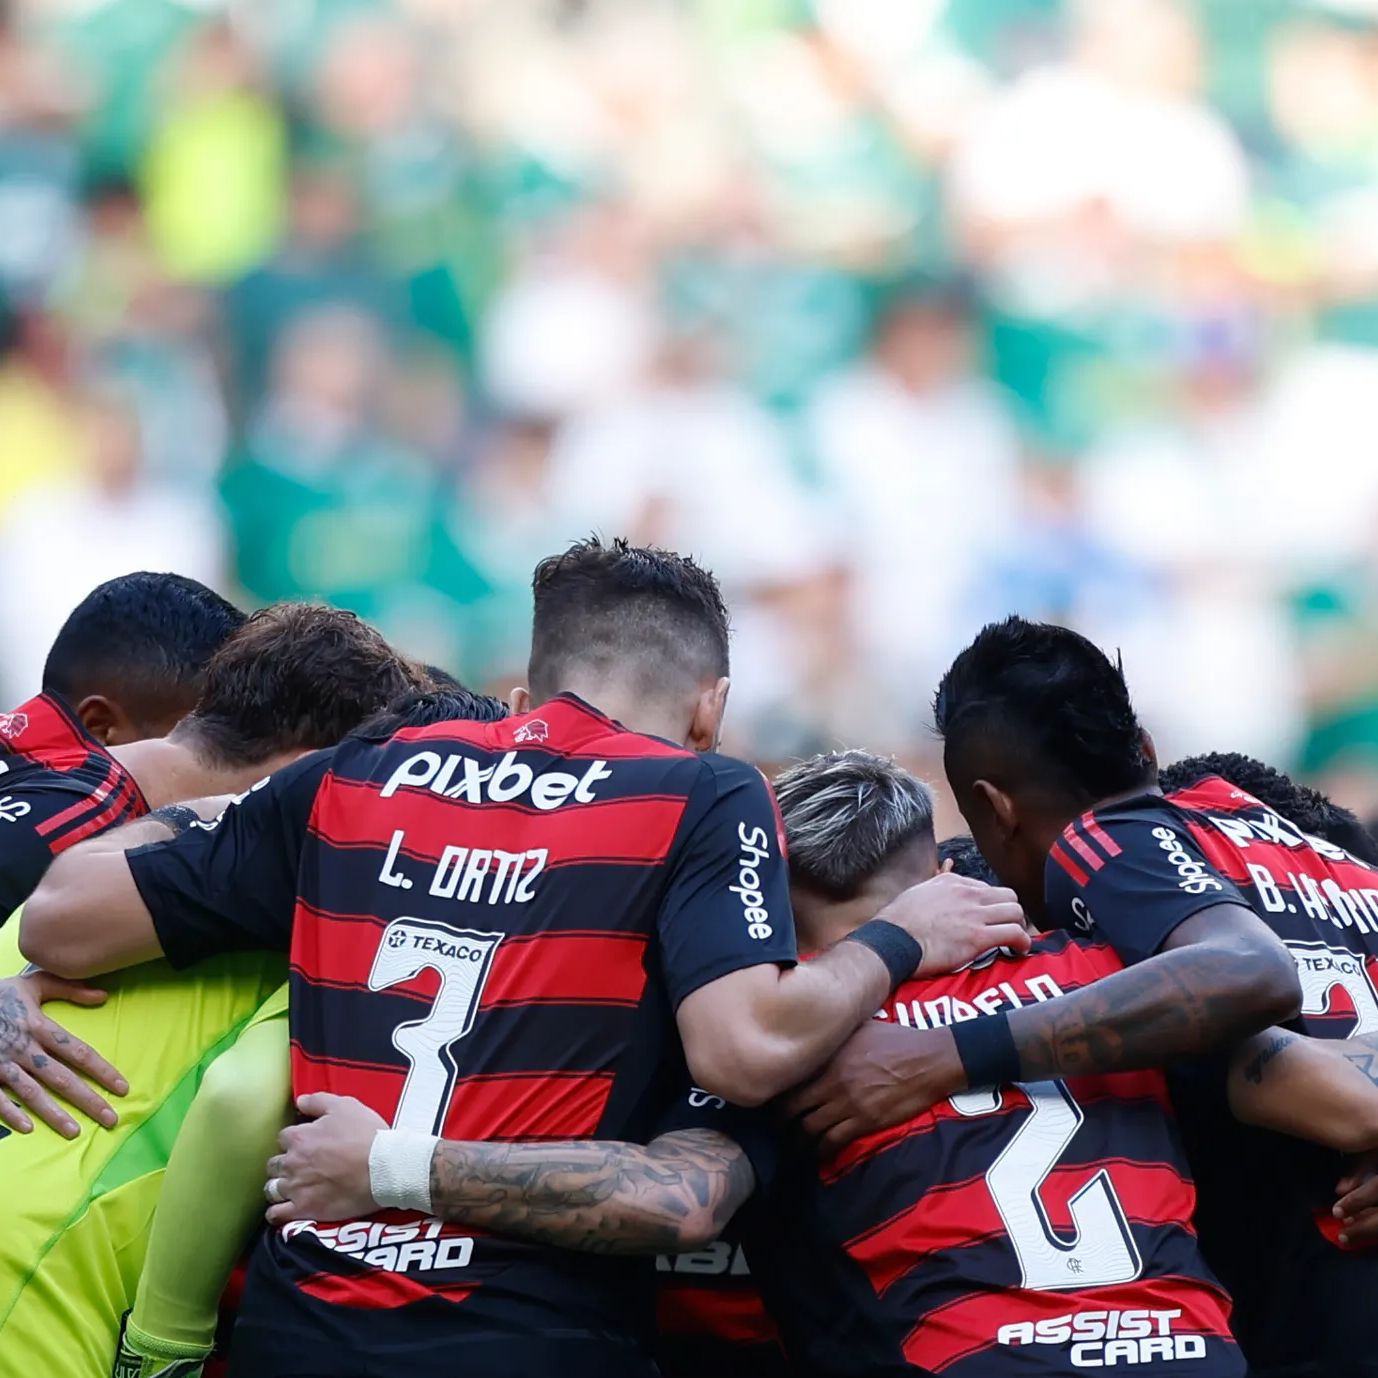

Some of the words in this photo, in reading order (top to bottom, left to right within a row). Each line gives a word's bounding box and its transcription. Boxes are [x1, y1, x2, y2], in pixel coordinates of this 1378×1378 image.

[379, 751, 613, 810] pixbet
[378, 829, 413, 889] L.
[428, 845, 548, 905] ORTIZ
[728, 821, 773, 940] Shopee
[1246, 863, 1297, 914] B.
[413, 935, 483, 963] TEXACO
[346, 1237, 474, 1273] ARD
[997, 1308, 1182, 1345] ASSIST
[1070, 1335, 1206, 1367] CARD
